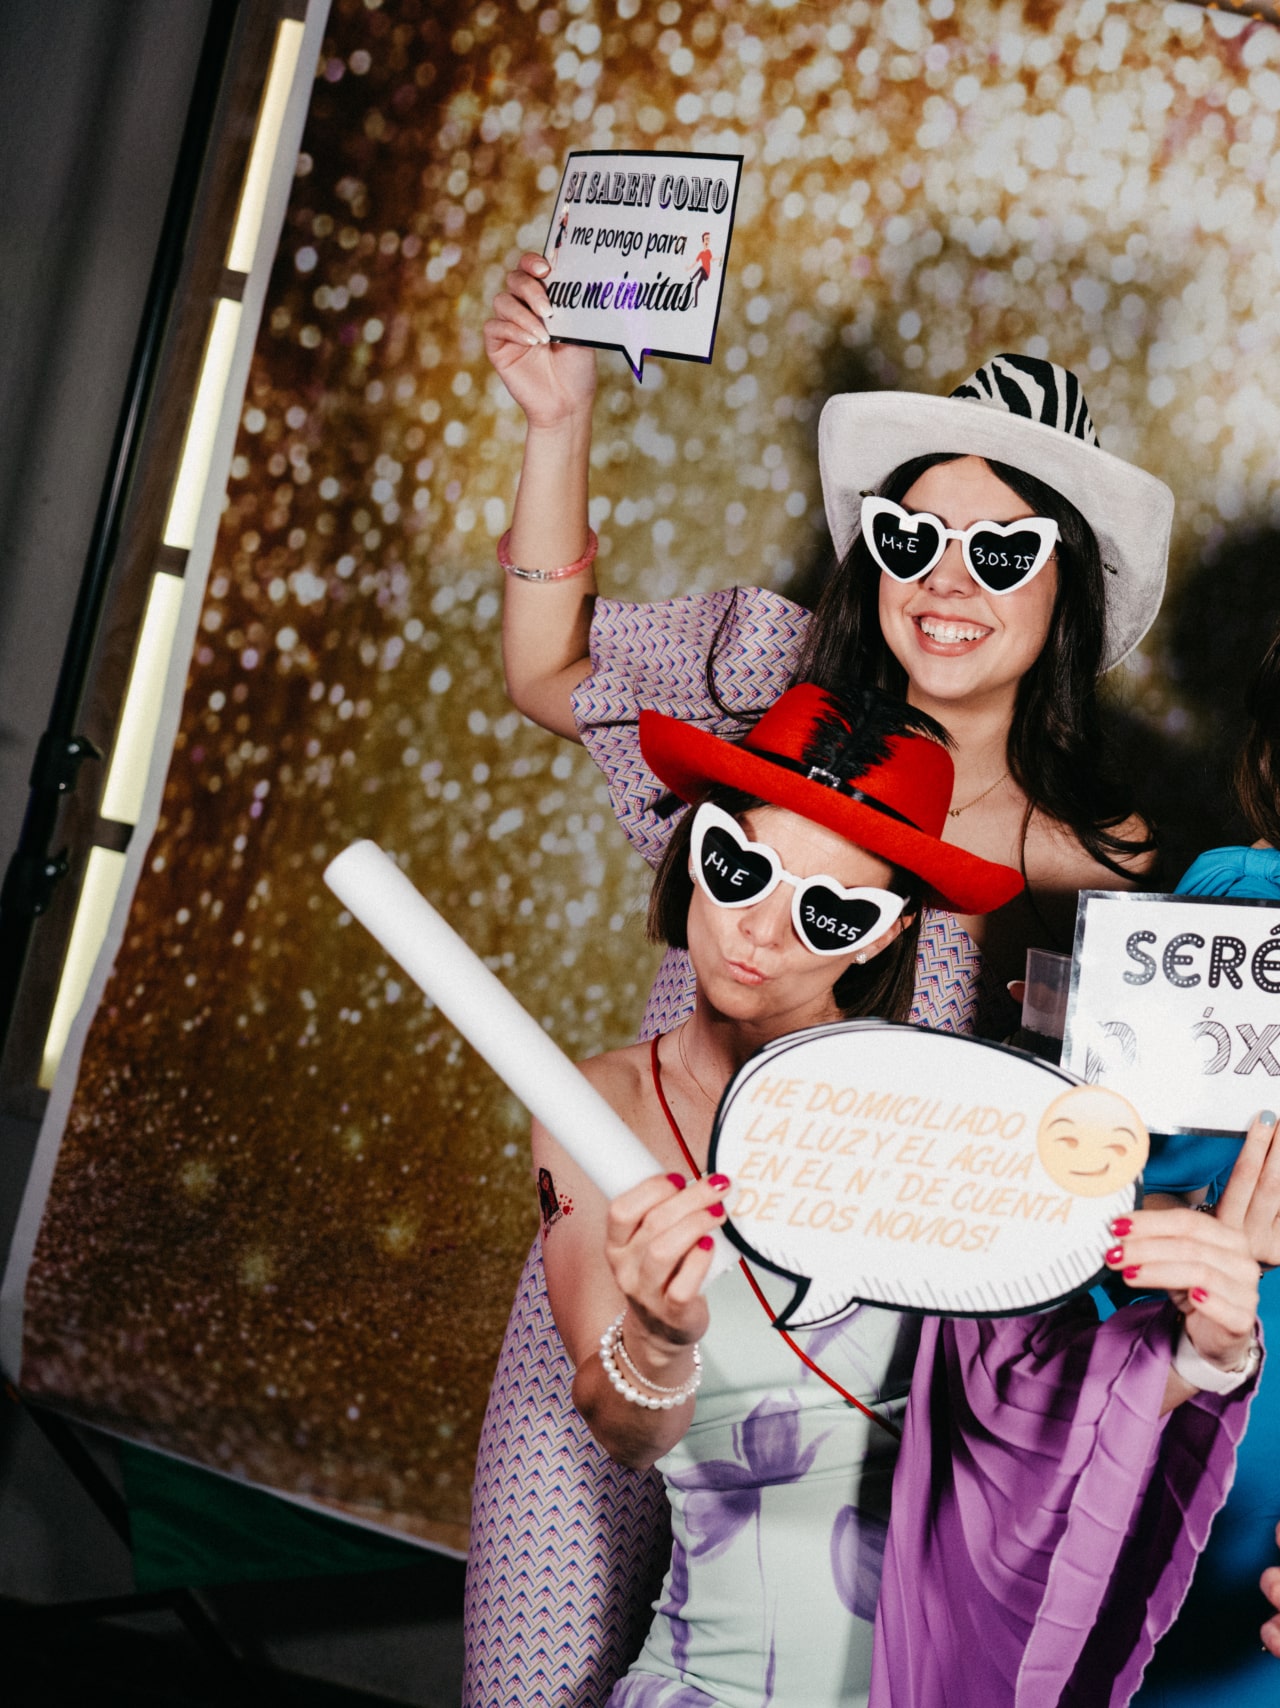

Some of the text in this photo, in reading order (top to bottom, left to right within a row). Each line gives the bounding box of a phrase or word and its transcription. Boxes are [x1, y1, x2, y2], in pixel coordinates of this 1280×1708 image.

[564, 171, 730, 214] SI SABEN COMO
[569, 225, 688, 259] me pongo para
[581, 281, 614, 310] me
[614, 271, 697, 311] invitas
[972, 547, 1036, 571] 3.05.25
[750, 1075, 1027, 1141] HE DOMICILIADO
[742, 1113, 1036, 1181] LA LUZ Y EL AGUA
[736, 1150, 793, 1183] EN
[791, 1157, 834, 1192] EL
[895, 1171, 950, 1207] DE
[951, 1180, 1074, 1225] CUENTA
[730, 1186, 1002, 1253] DE LOS NOVIOS!
